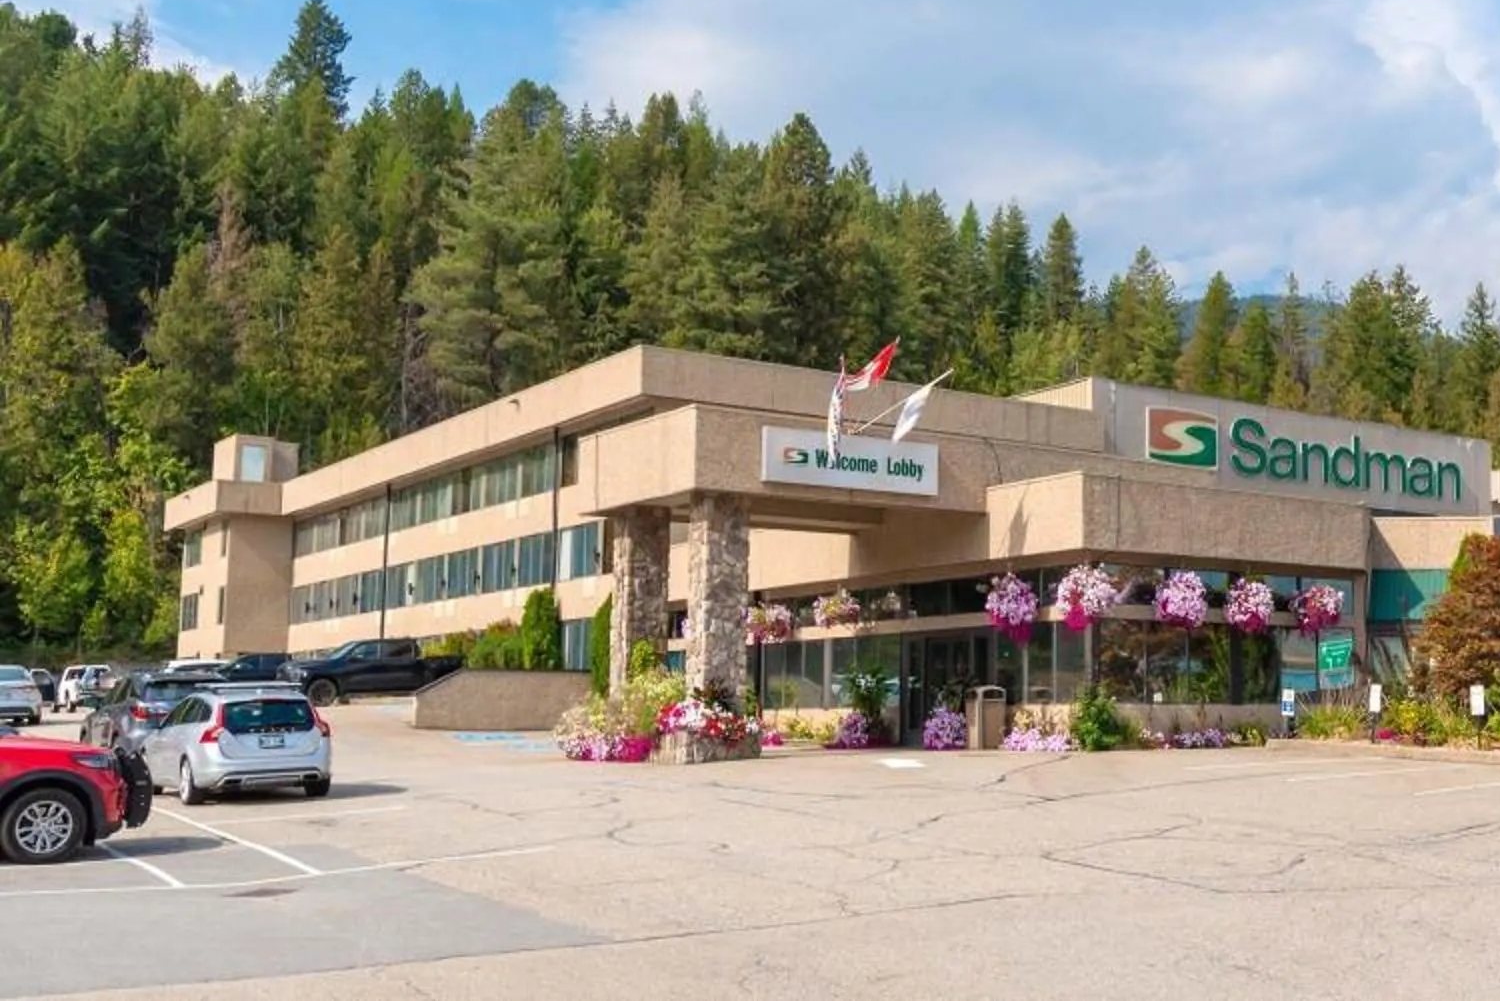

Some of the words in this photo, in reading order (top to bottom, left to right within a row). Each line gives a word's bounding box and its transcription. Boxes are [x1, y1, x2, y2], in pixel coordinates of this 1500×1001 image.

[815, 448, 878, 474] Wlcome
[886, 456, 925, 482] Lobby
[1230, 417, 1461, 501] Sandman
